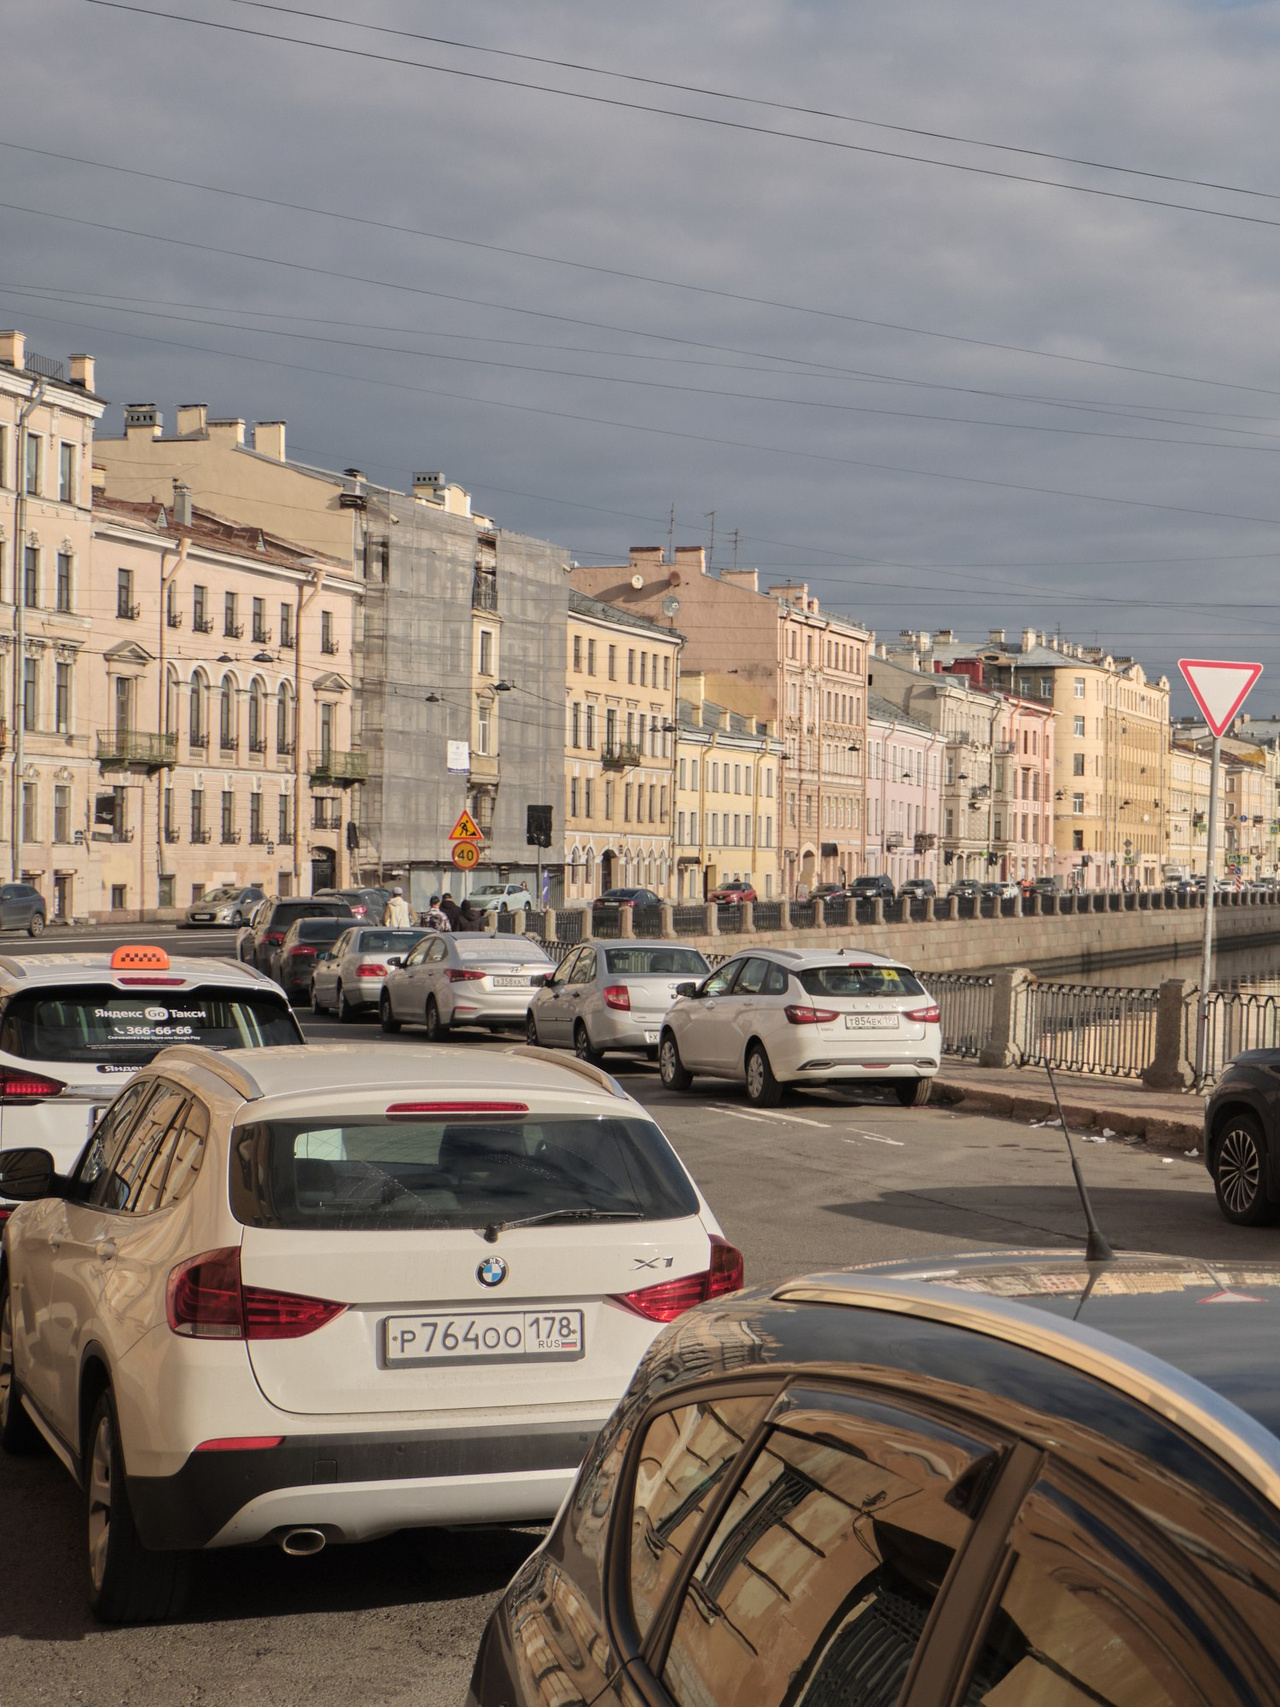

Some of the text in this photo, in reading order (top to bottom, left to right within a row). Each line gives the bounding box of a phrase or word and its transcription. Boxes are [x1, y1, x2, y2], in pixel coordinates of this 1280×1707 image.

[457, 849, 474, 861] 40
[94, 1008, 207, 1019] Яндекс Go Такси
[126, 1026, 193, 1035] 366-66-66
[628, 1256, 674, 1271] X1
[528, 1316, 571, 1340] 178
[538, 1339, 561, 1348] RUS
